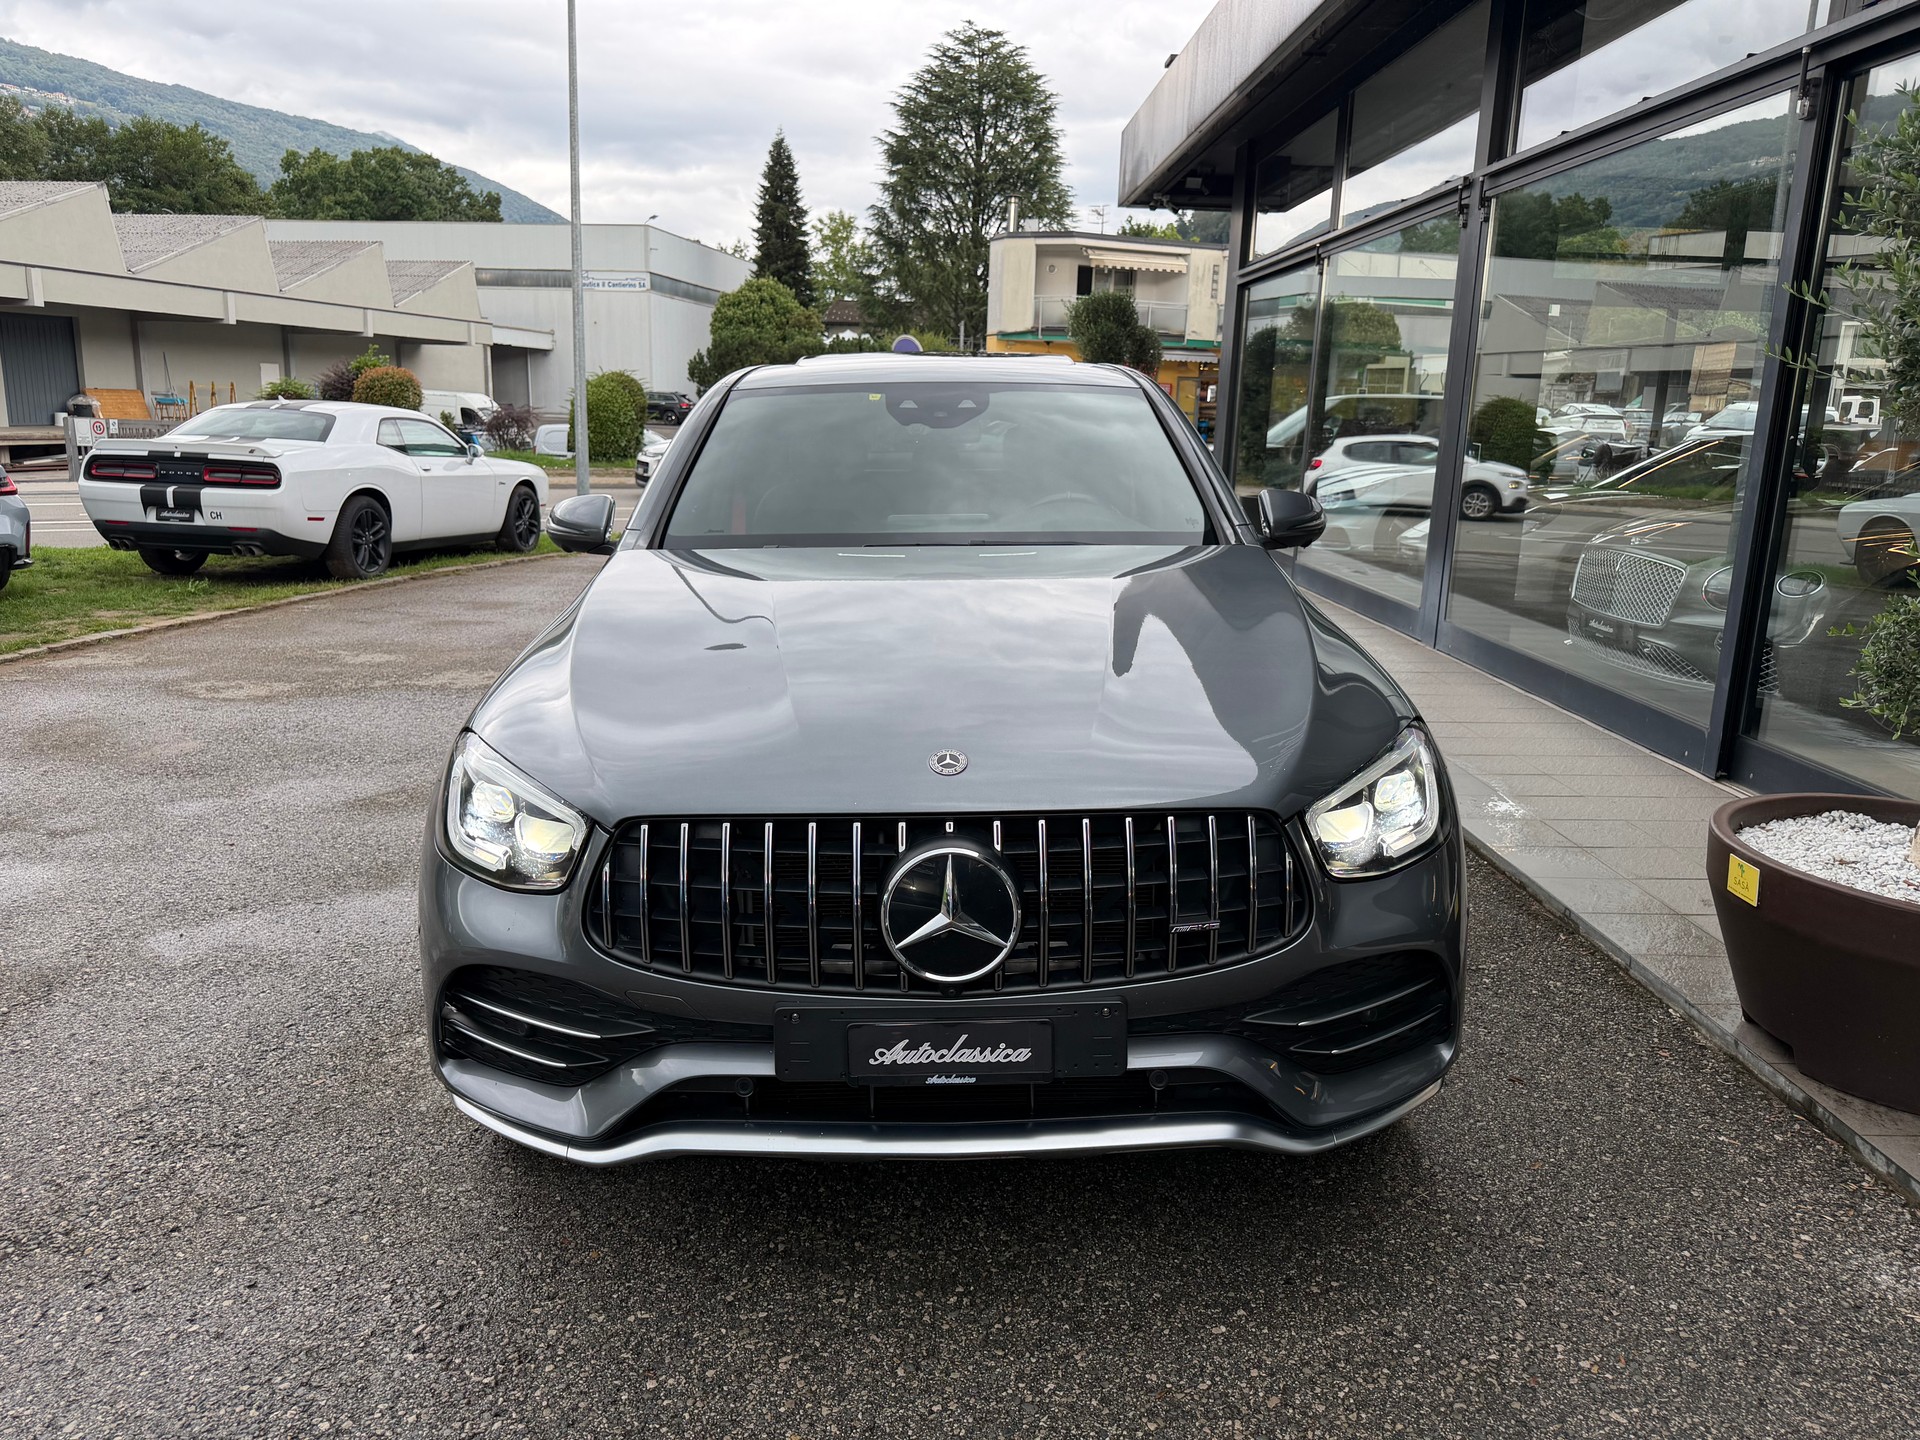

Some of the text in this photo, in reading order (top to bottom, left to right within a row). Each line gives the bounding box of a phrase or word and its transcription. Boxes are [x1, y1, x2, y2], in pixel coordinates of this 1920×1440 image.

[95, 424, 102, 432] 15
[209, 510, 223, 520] CH
[868, 1033, 1033, 1066] Autoclassica
[925, 1074, 977, 1085] Autoclassica
